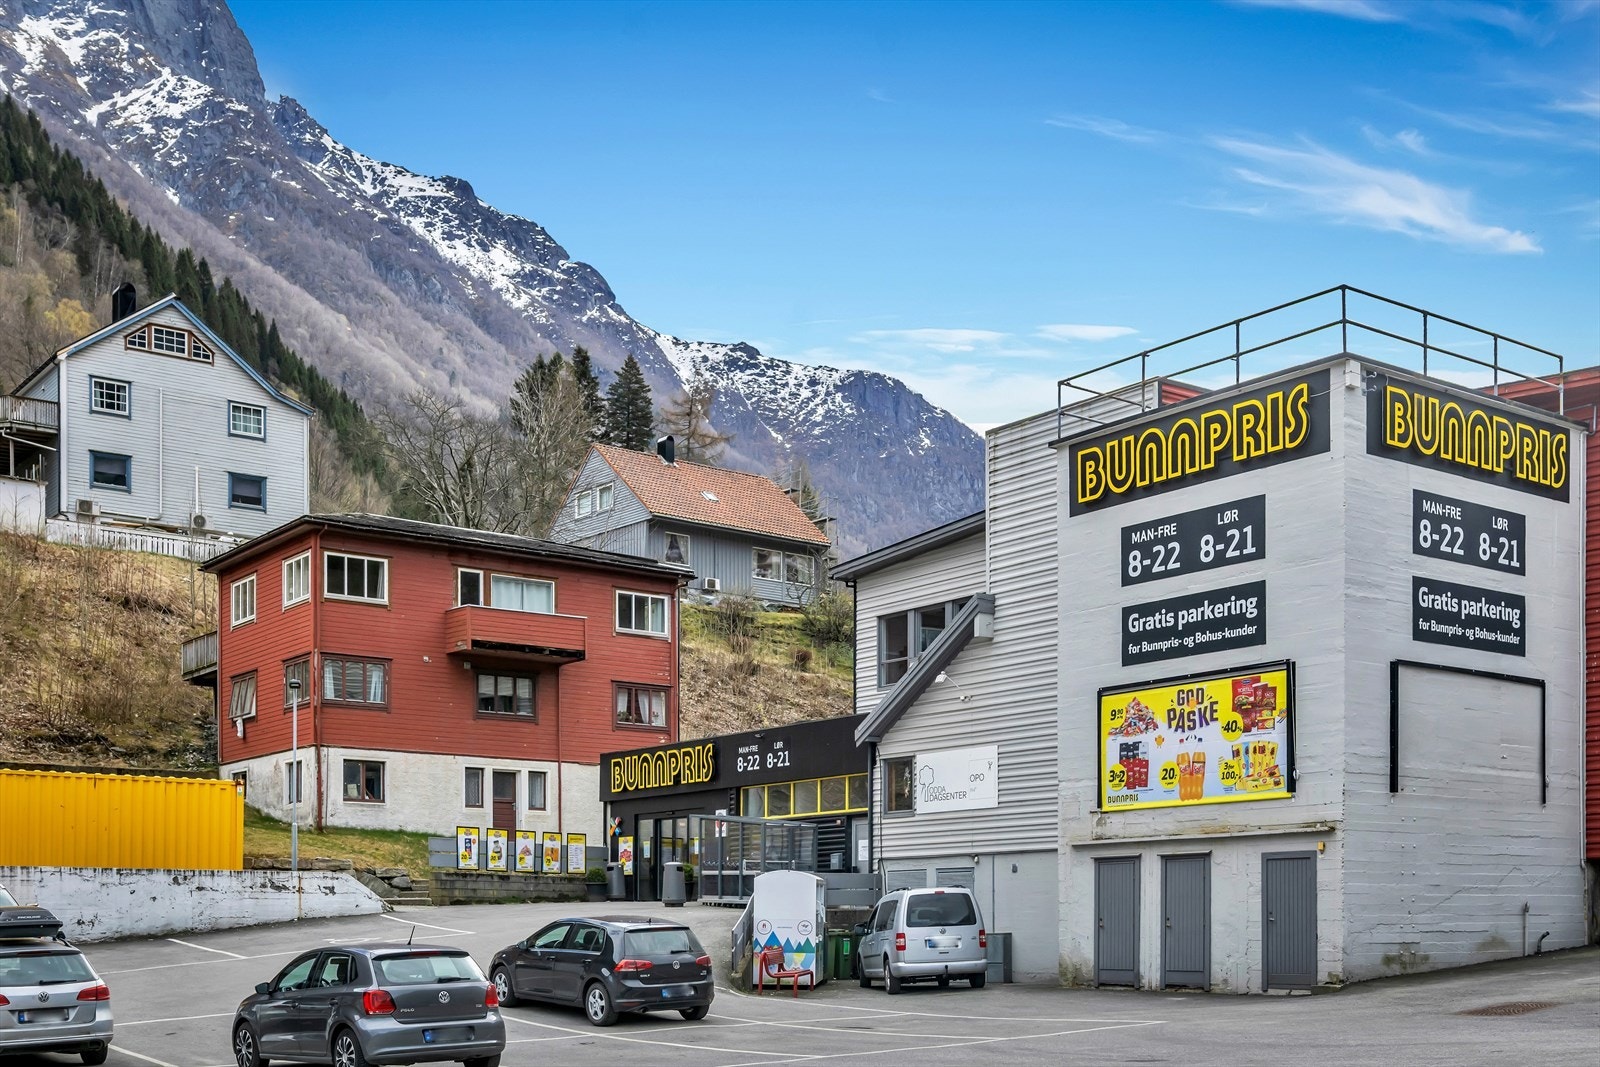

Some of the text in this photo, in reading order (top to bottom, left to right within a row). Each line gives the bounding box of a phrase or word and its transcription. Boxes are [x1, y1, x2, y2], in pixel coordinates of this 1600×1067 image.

[1077, 382, 1310, 503] BUNNPRIS
[1386, 385, 1567, 489] BUNNPRIS
[1217, 509, 1239, 525] LØR
[1422, 499, 1462, 521] MAN-FRE
[1131, 522, 1177, 544] MAN-FRE
[1492, 516, 1509, 532] LØR
[1128, 525, 1256, 578] 8-22 8-21
[1419, 519, 1520, 568] 8-22 8-21
[1128, 595, 1258, 633] Gratis parkering
[1418, 586, 1521, 629] Gratis parkering
[1128, 624, 1258, 655] for Bunnpris- og Bohus-kunder
[1418, 619, 1521, 645] for Bunnpris- og Bohus-kunder
[1177, 687, 1205, 706] GOD
[1167, 700, 1219, 733] PÅSKE
[738, 744, 759, 754] MAN-FRE
[773, 741, 784, 749] LØR
[611, 743, 714, 793] BUNNPRIS
[737, 750, 790, 772] 8-22 8-21
[929, 790, 968, 802] DAGSENTER
[1107, 793, 1139, 804] BUNNPRIS
